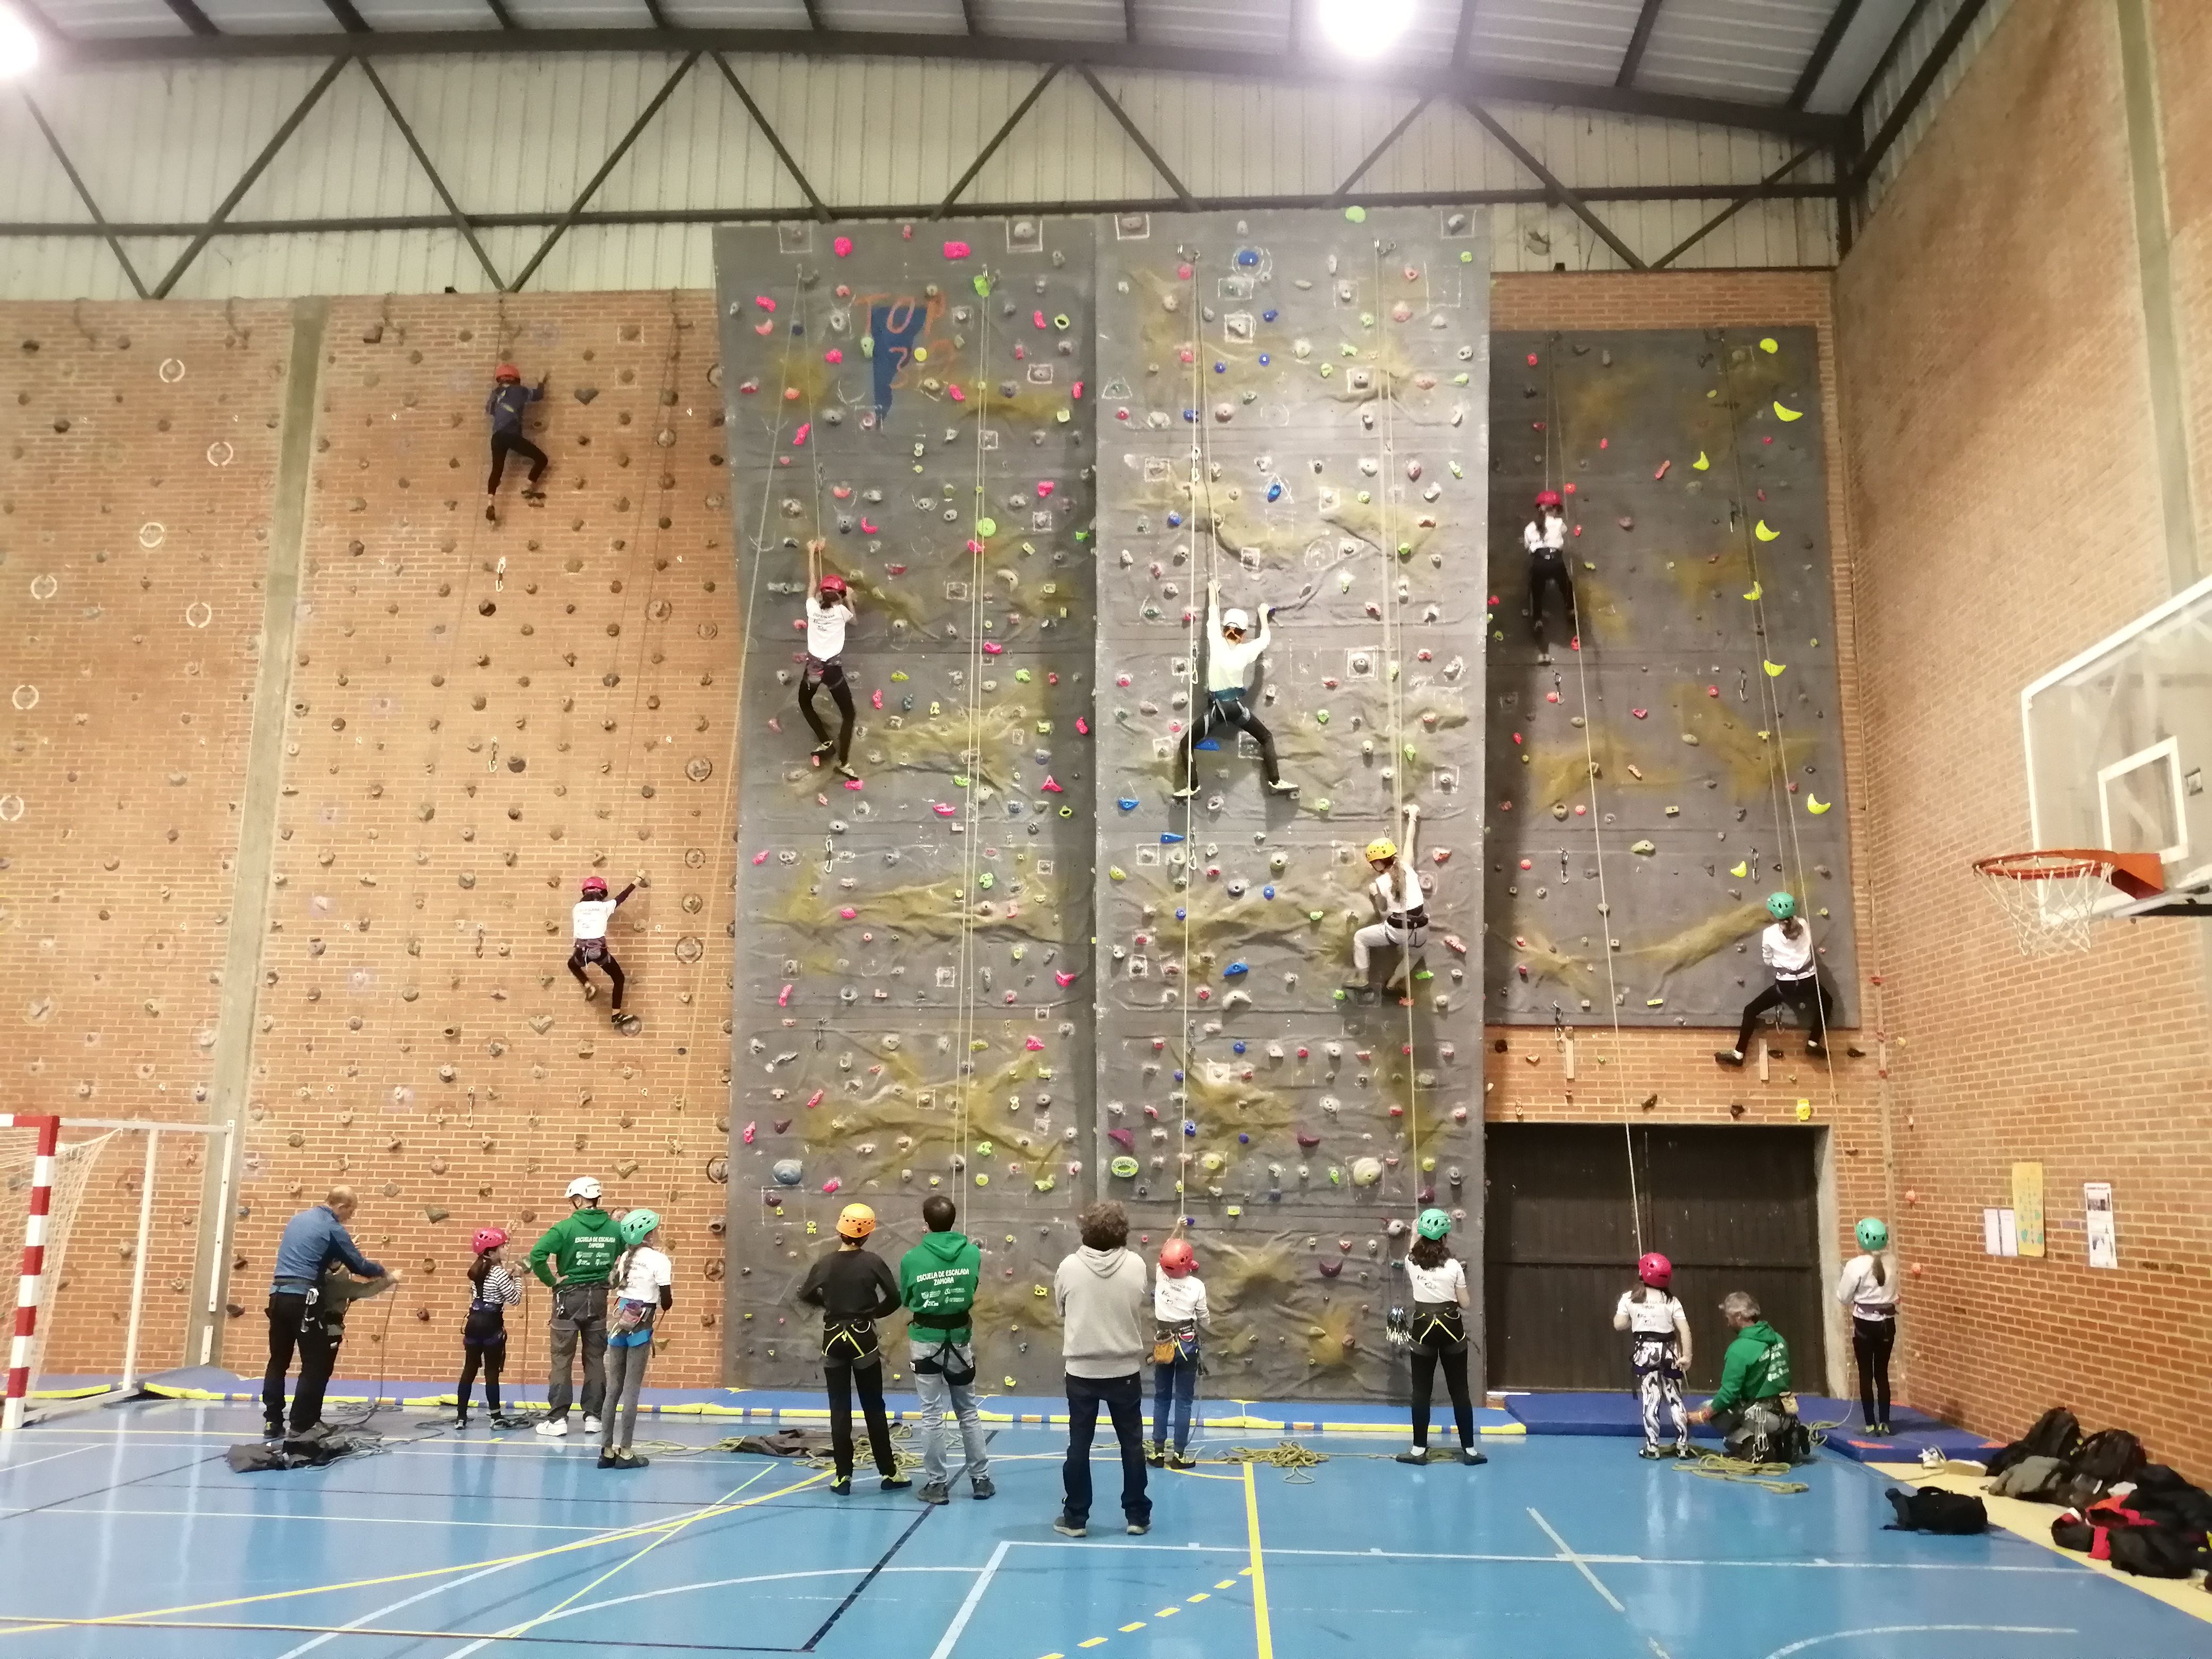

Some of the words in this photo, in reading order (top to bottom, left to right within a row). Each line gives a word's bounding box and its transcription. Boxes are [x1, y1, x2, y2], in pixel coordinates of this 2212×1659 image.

[917, 1271, 938, 1283] ESCUELA
[946, 1268, 969, 1277] ESCALADA
[934, 1276, 954, 1286] ZAMORA
